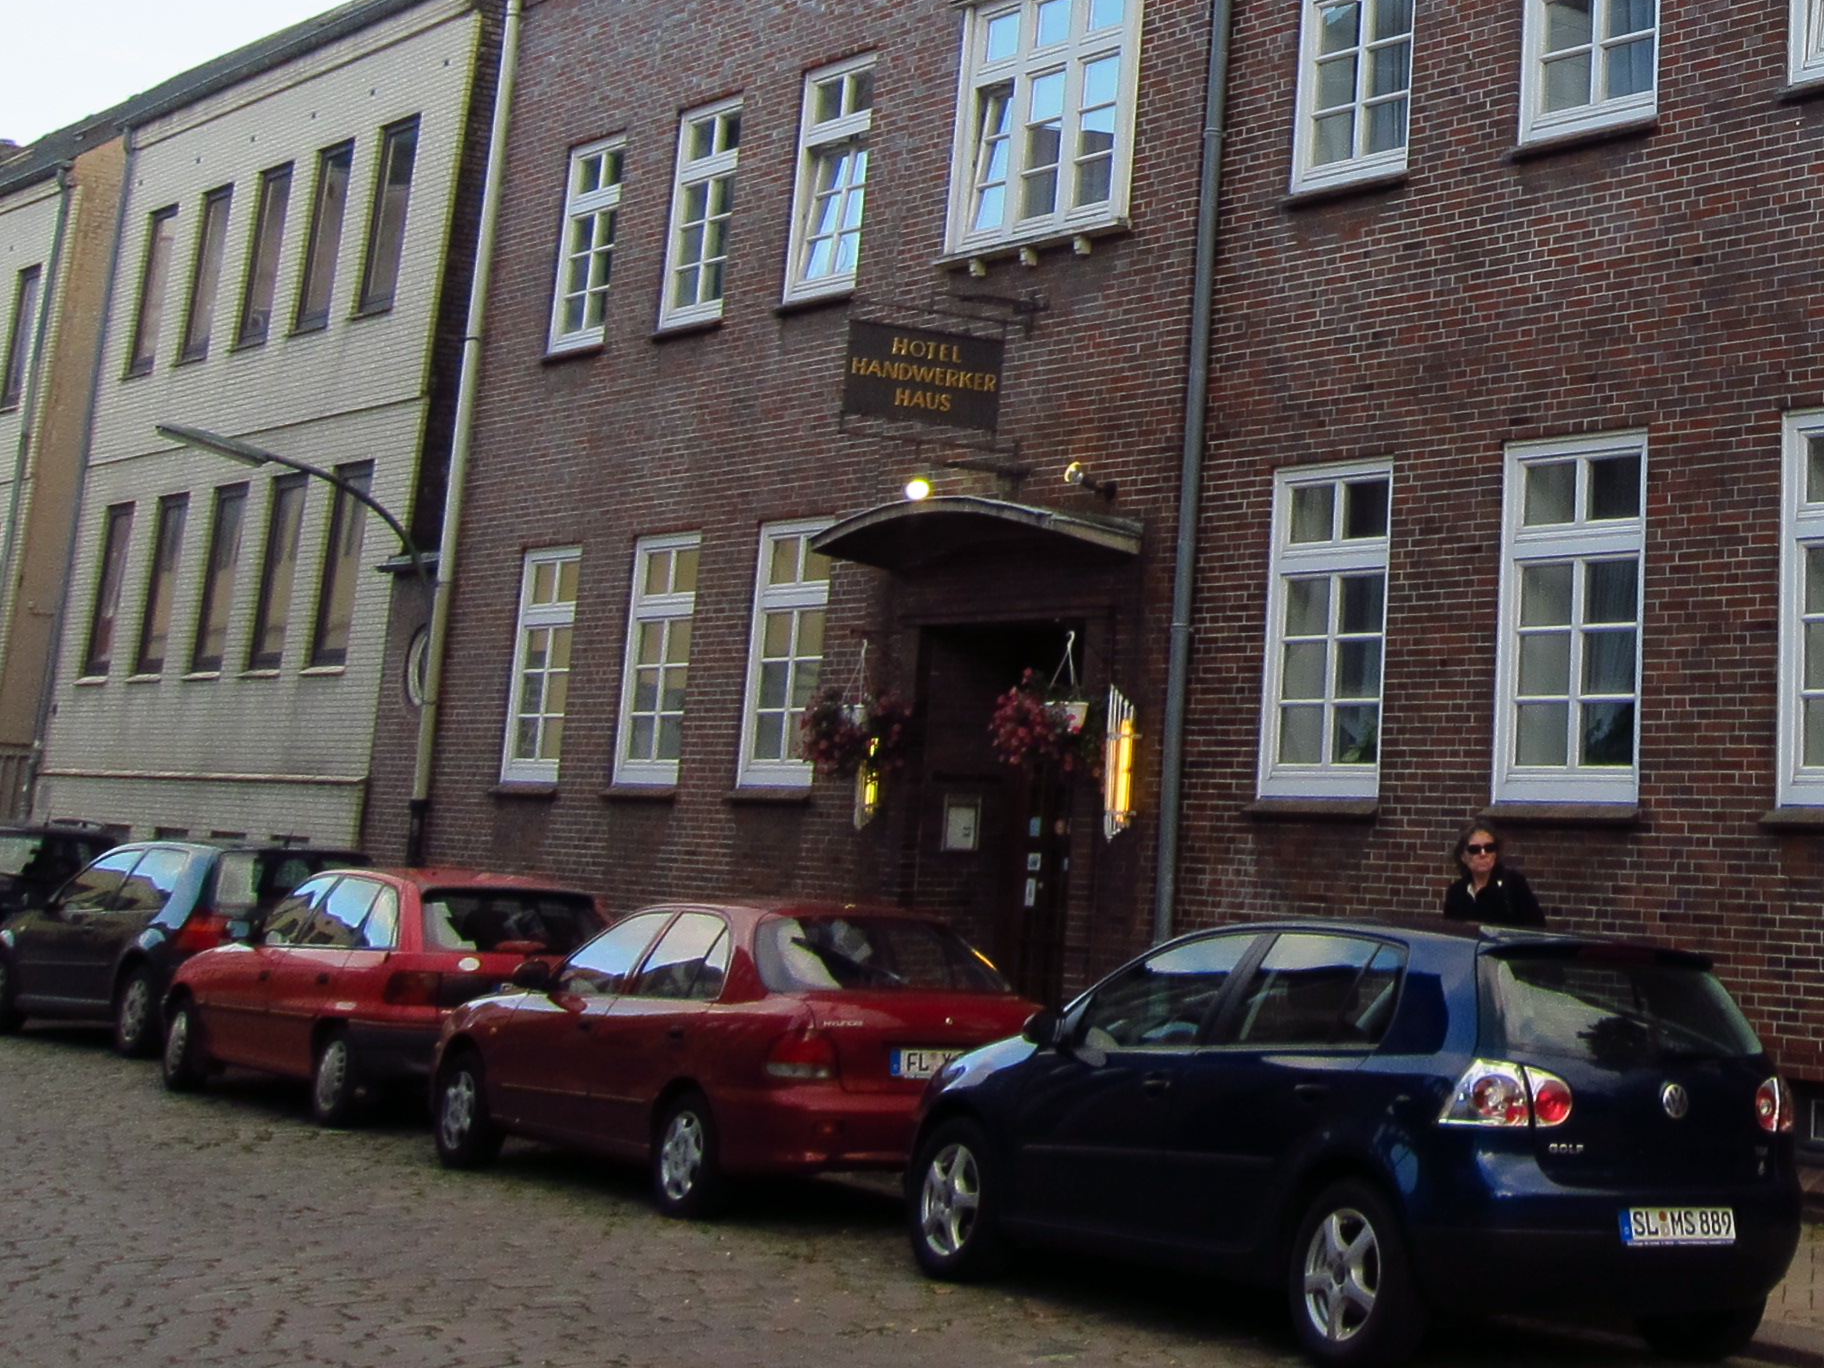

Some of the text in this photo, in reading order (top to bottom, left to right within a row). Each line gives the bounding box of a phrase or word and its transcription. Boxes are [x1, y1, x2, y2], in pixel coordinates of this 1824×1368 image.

[891, 336, 962, 364] HOTEL
[851, 357, 997, 392] HANDWERKER
[894, 387, 951, 412] HAUS
[906, 1052, 929, 1072] FL
[1548, 1142, 1585, 1155] GOLF
[1632, 1210, 1732, 1236] SL MS 889
